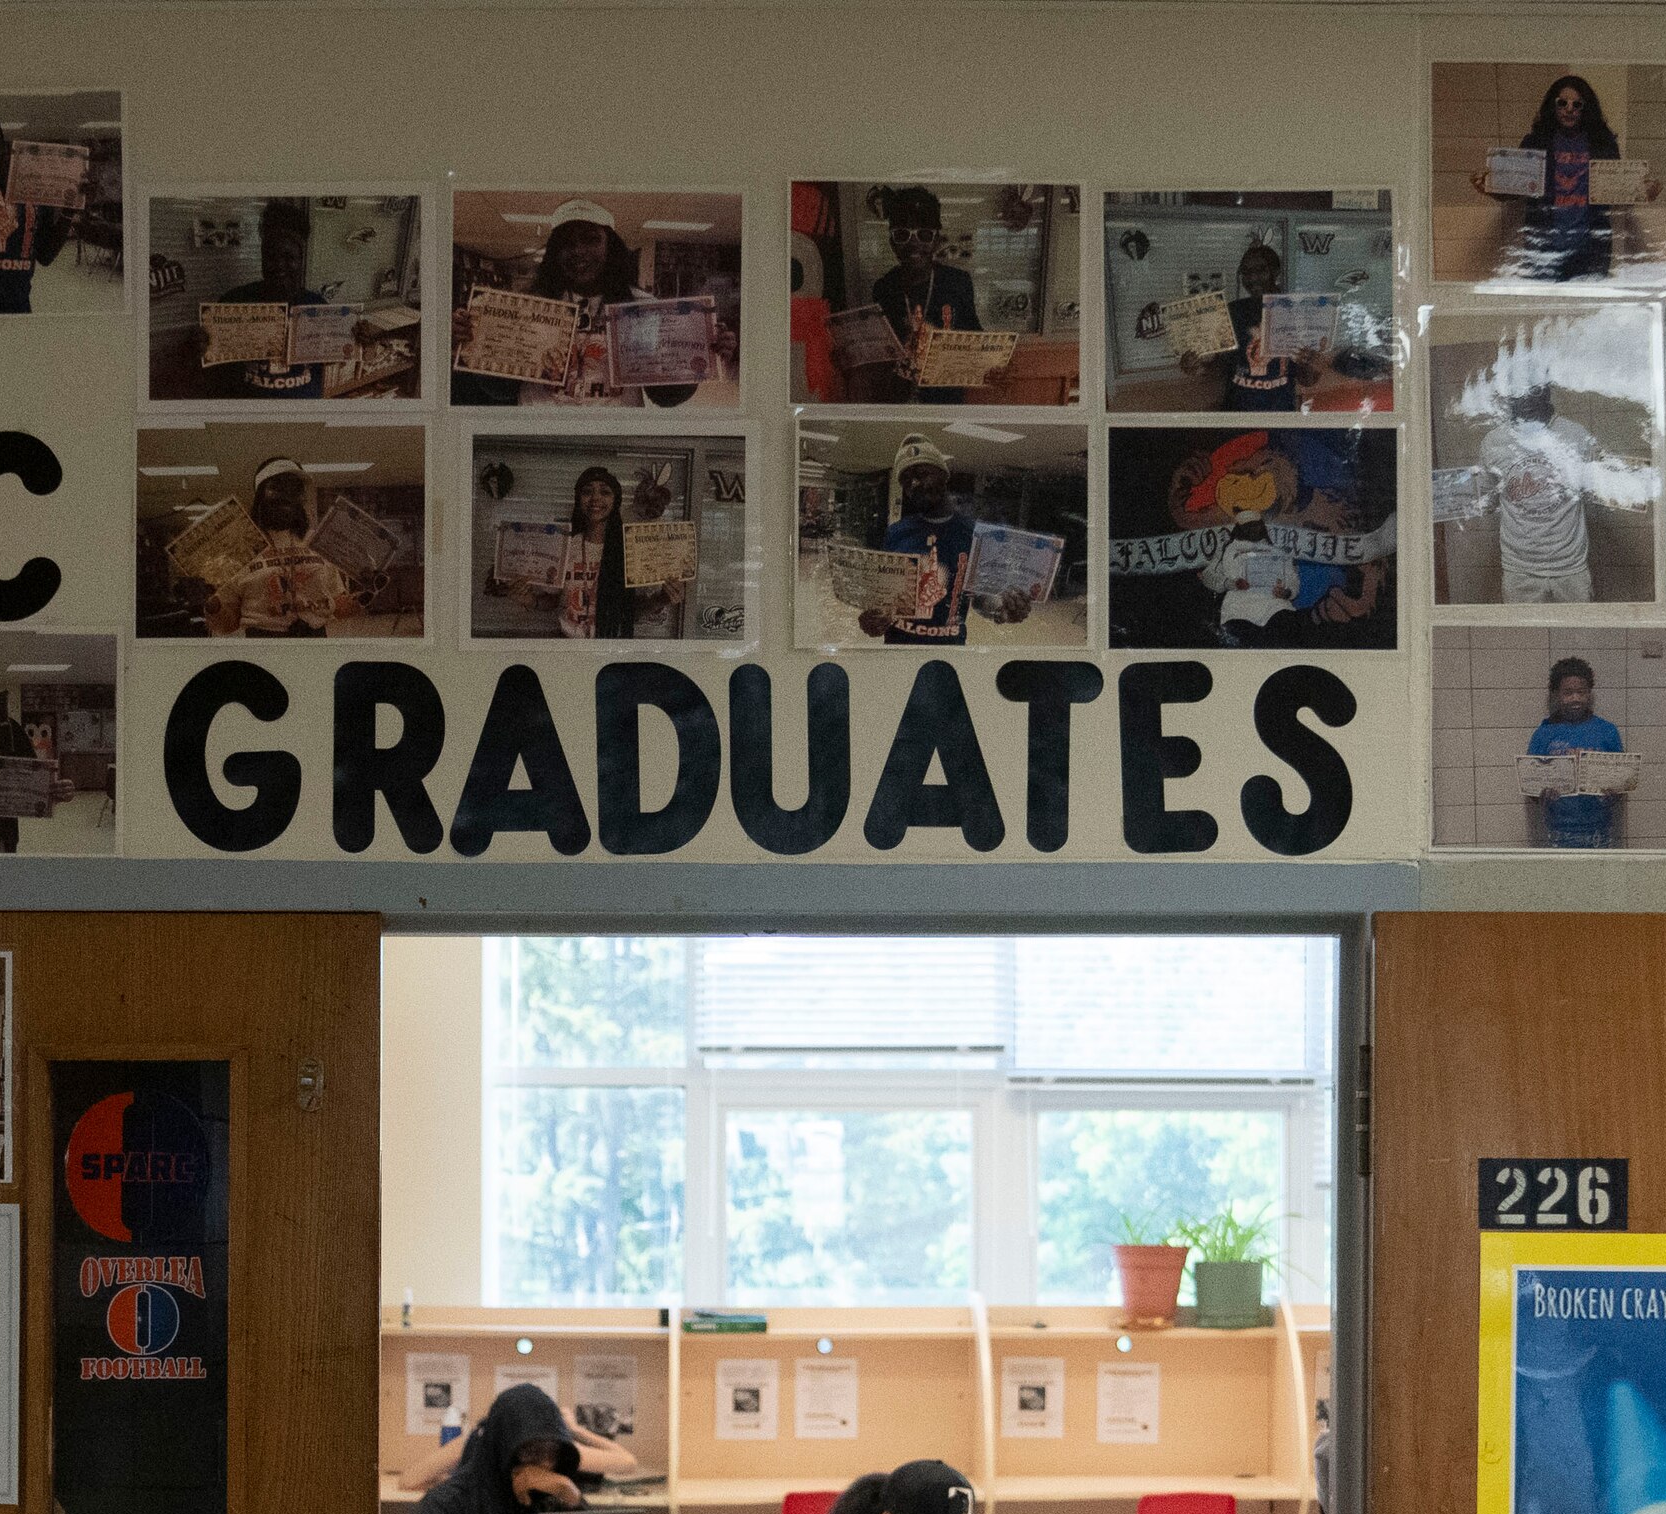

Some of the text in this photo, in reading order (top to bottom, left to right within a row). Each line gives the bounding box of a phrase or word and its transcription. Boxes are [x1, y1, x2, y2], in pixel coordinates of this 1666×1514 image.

[164, 660, 1357, 855] GRADUATES
[82, 1152, 195, 1183] SPARC
[1494, 1166, 1611, 1226] 226
[79, 1256, 207, 1299] OVERLEA
[1534, 1283, 1615, 1321] BROKEN
[80, 1357, 208, 1381] FOOTBALL
